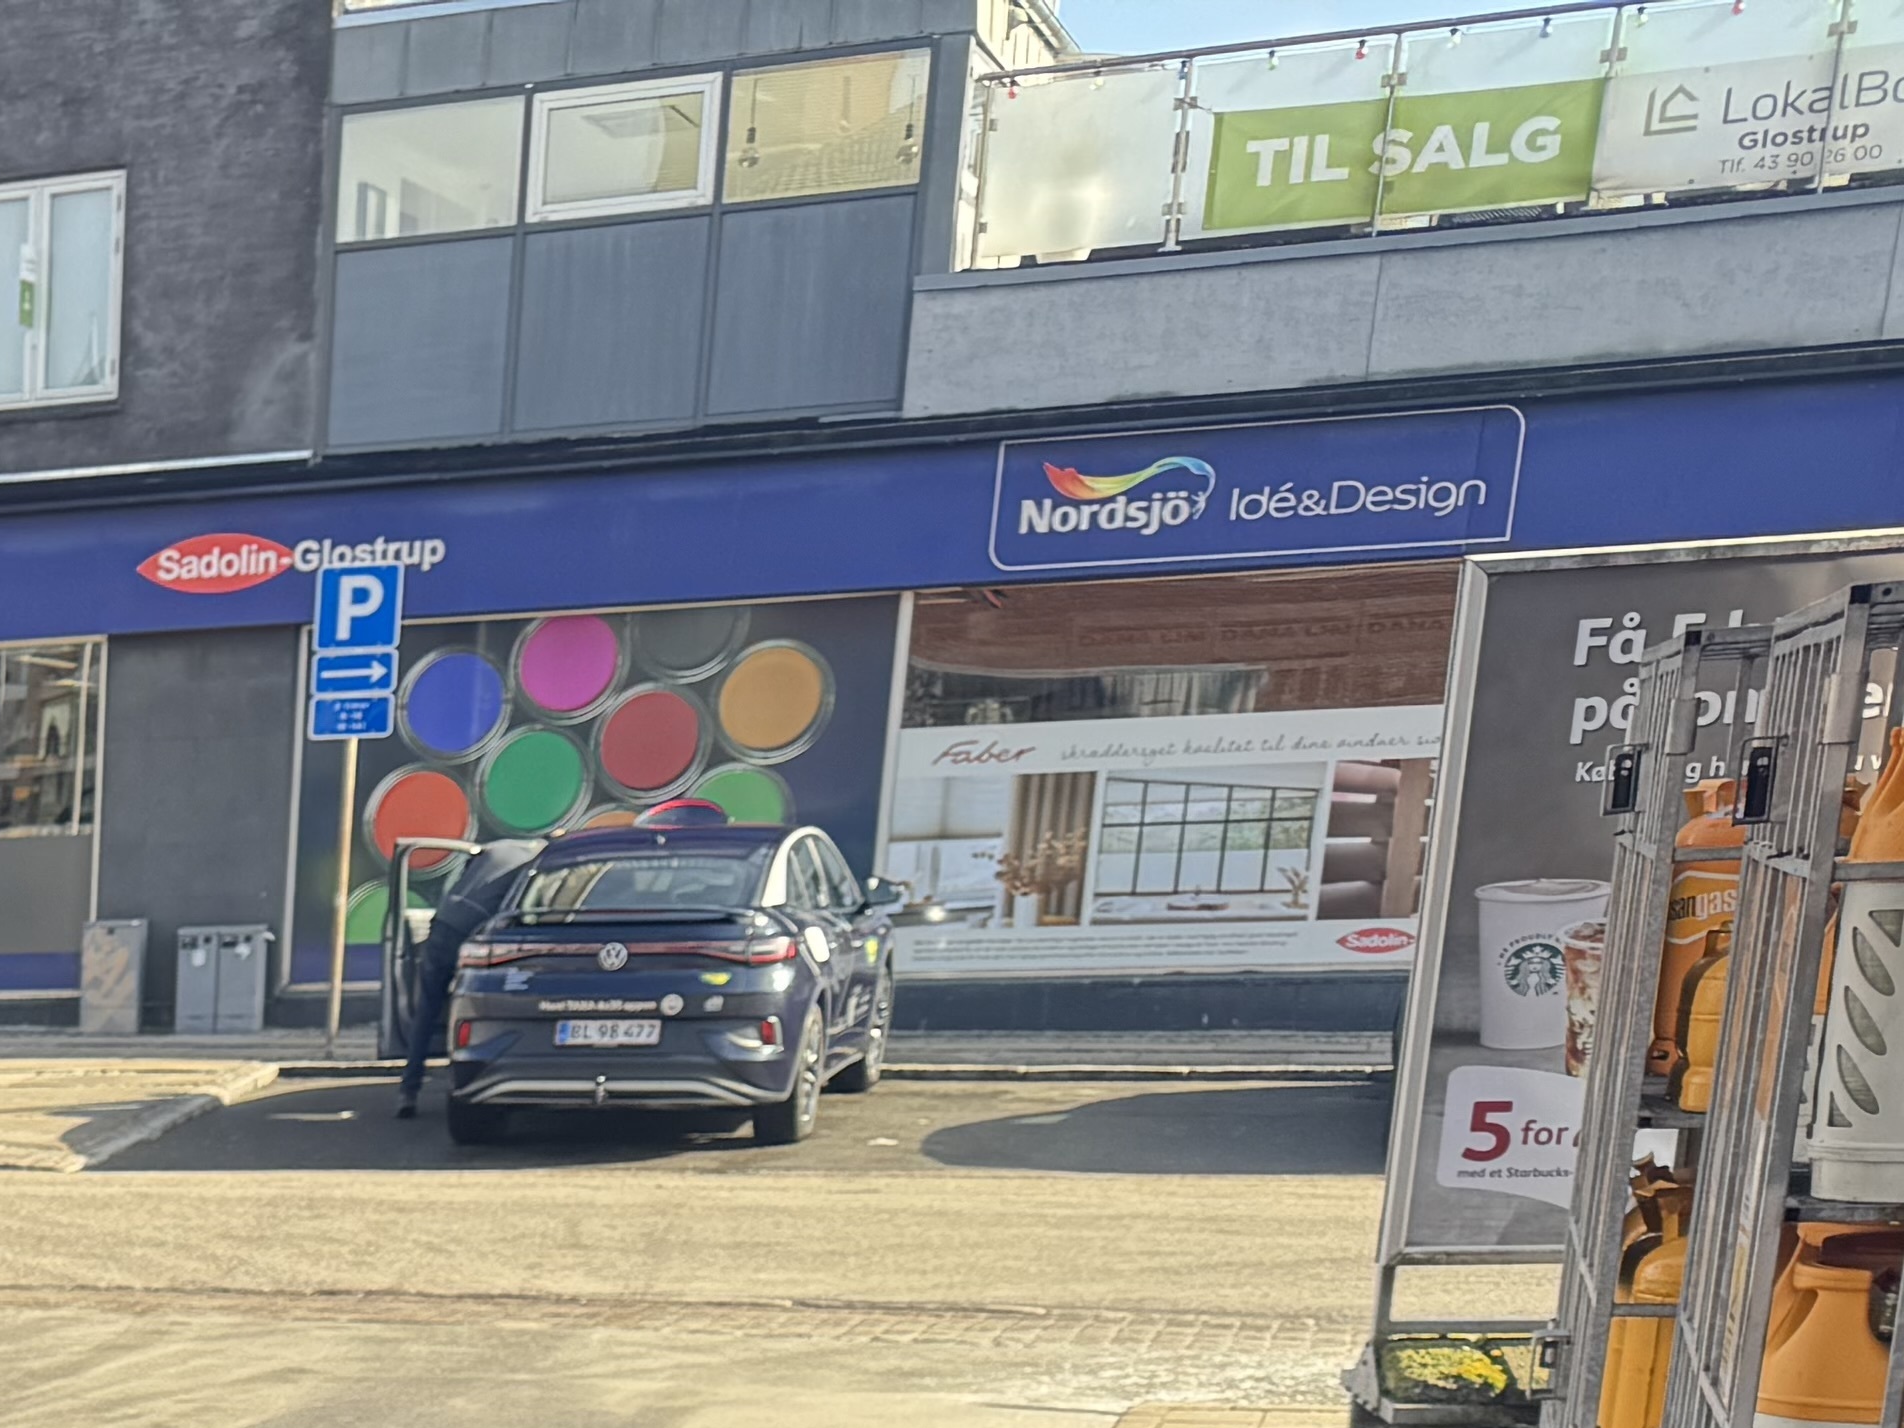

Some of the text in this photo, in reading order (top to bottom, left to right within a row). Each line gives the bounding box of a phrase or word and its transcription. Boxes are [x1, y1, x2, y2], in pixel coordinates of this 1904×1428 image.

[1246, 115, 1562, 187] TIL SALG
[1738, 122, 1871, 151] Glostrup
[1754, 154, 1780, 171] 43
[1786, 151, 1814, 168] 90
[1854, 144, 1883, 161] 00
[1017, 475, 1487, 536] Nordsjö Idé&Design
[156, 536, 447, 581] Sadolin-Glostrup
[335, 574, 385, 641] P
[1574, 612, 1647, 666] Få
[1570, 677, 1641, 745] på
[932, 740, 1036, 766] Faber
[1260, 733, 1286, 752] til
[1291, 736, 1331, 751] dine
[1335, 732, 1410, 749] vinduer
[1668, 889, 1738, 920] sangas
[571, 1023, 657, 1039] BL 98 477
[1461, 1100, 1513, 1162] 5
[1521, 1120, 1570, 1146] for
[1457, 1168, 1486, 1179] med
[1489, 1168, 1502, 1179] et
